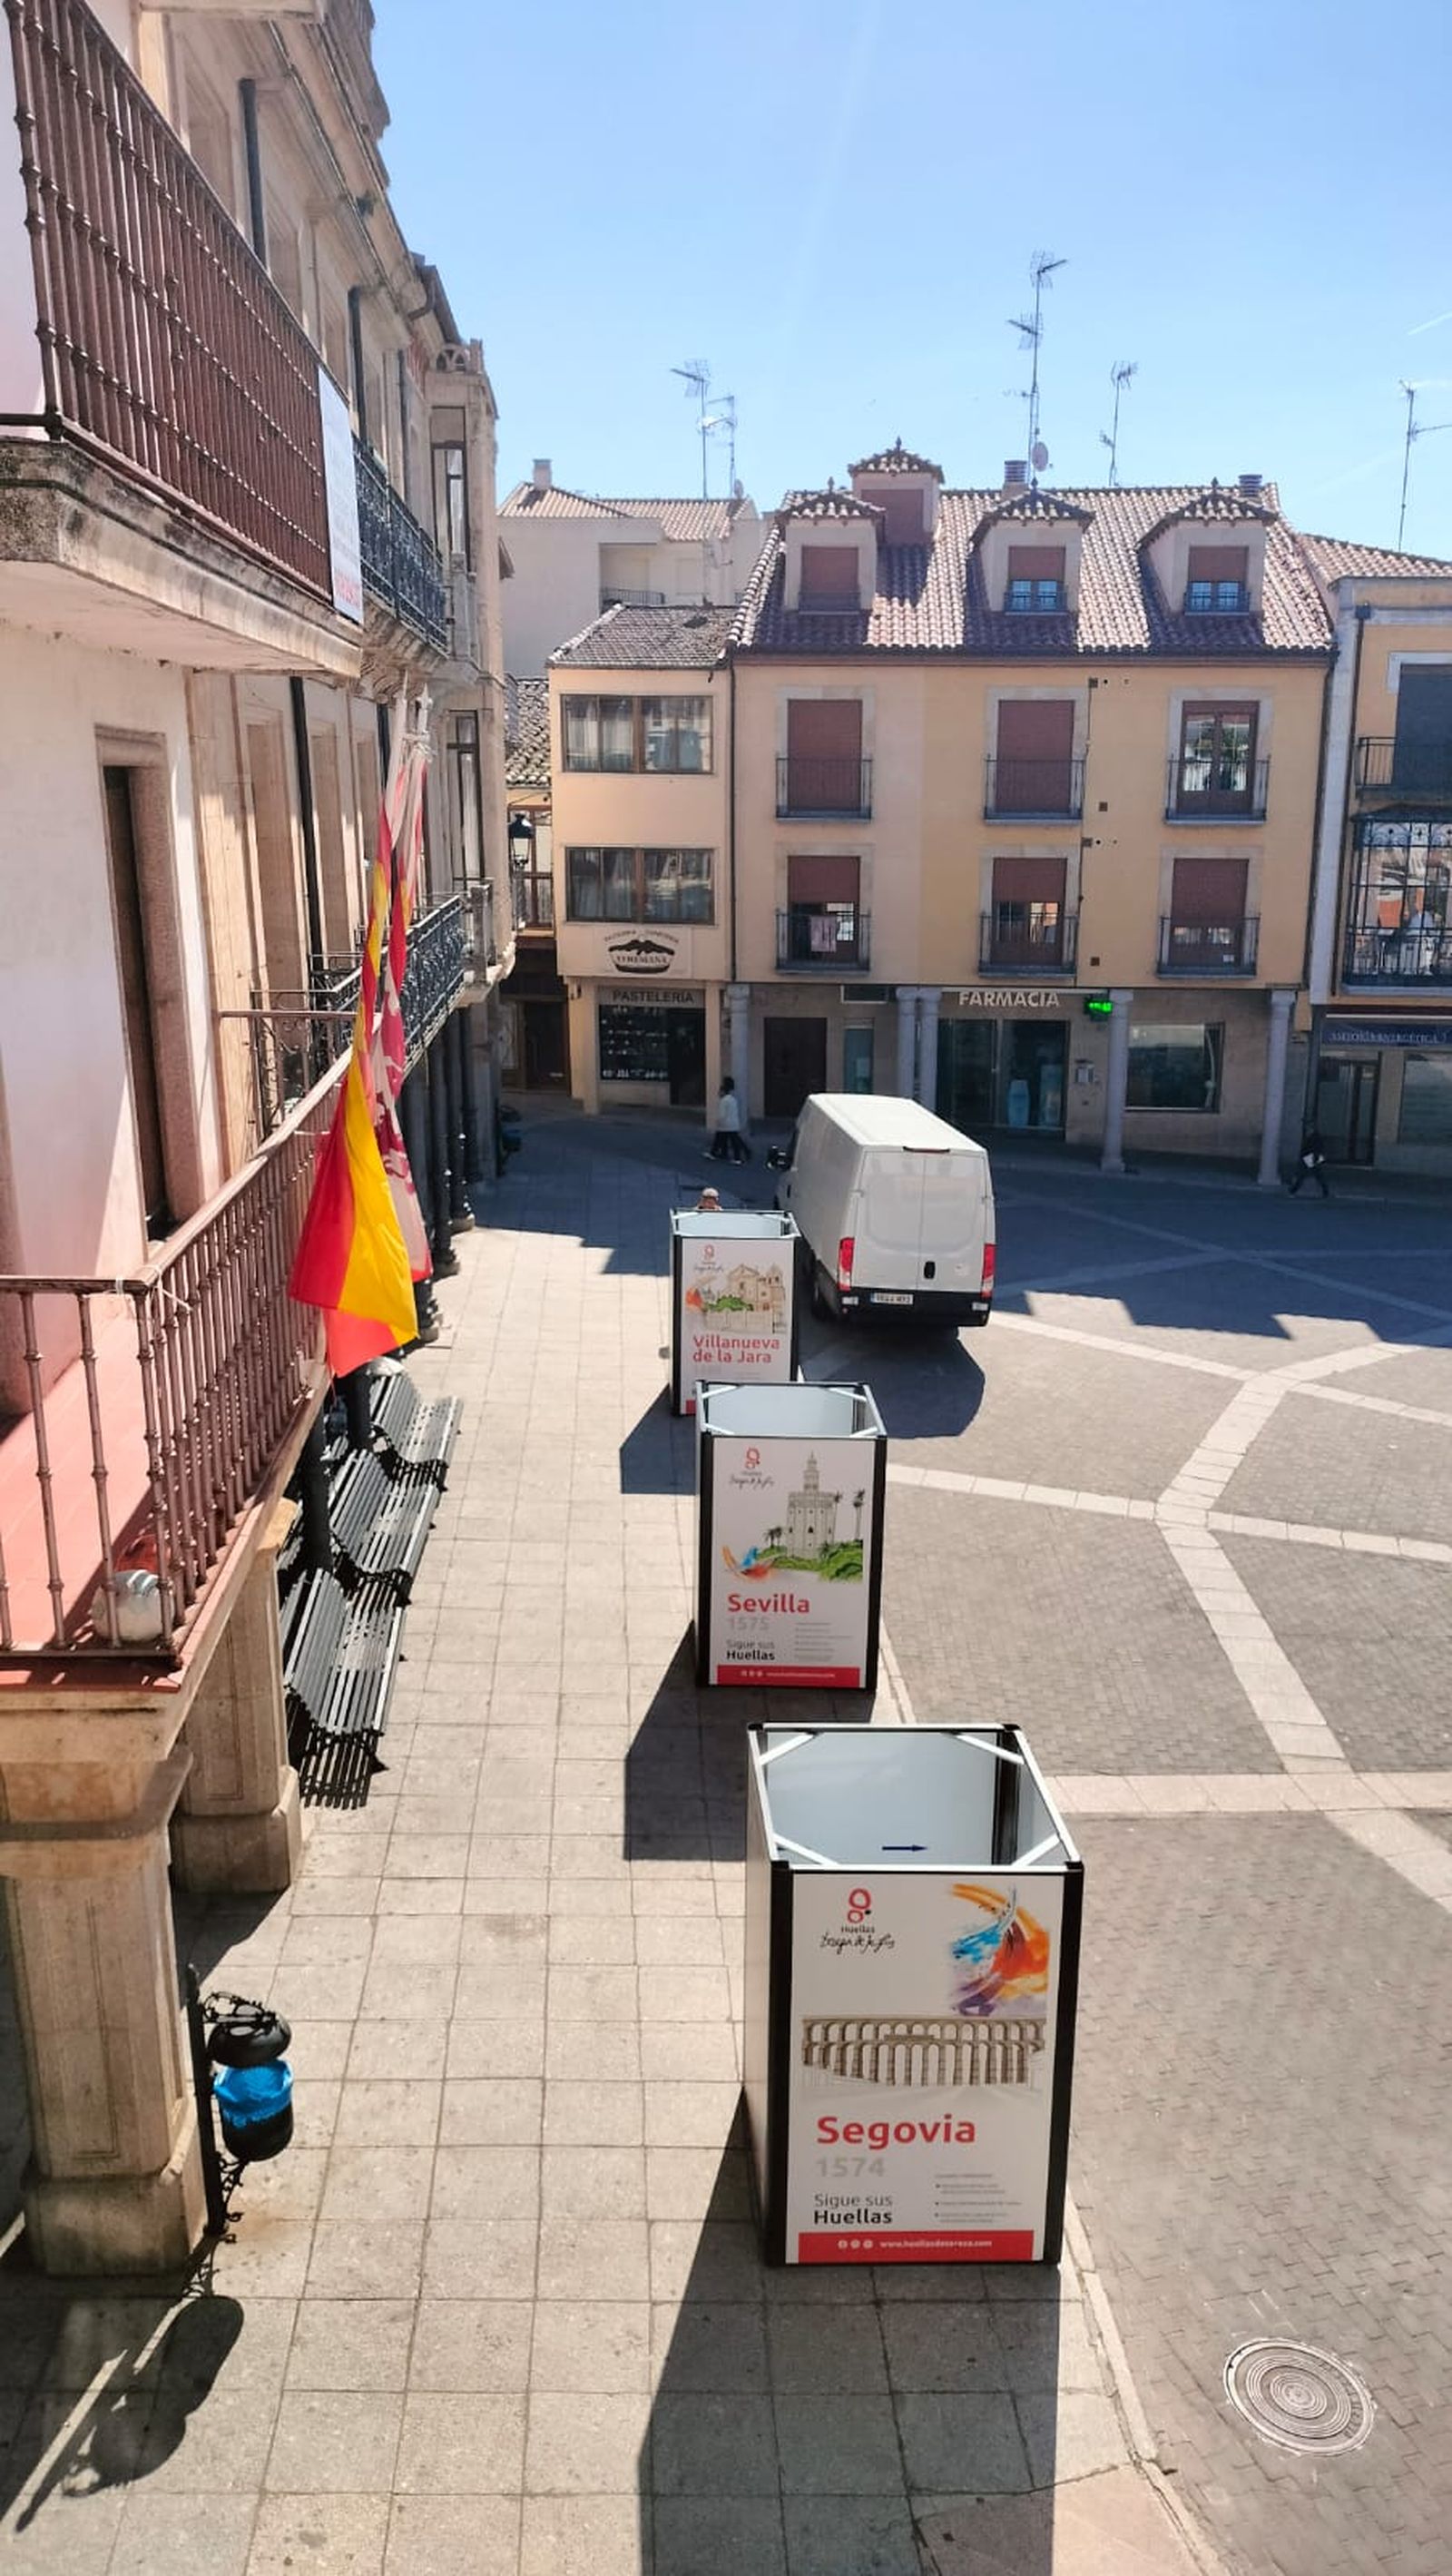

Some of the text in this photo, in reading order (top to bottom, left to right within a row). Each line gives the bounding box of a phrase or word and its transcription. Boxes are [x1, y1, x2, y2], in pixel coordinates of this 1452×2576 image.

[959, 991, 1060, 1008] FARMACIA
[692, 1334, 780, 1350] Villanueva
[692, 1349, 772, 1363] de la Jara
[727, 1593, 810, 1614] Sevilla
[727, 1617, 770, 1631] 1575
[726, 1649, 776, 1661] Huellas
[817, 2114, 976, 2149] Segovia
[815, 2156, 886, 2178] 1574
[814, 2193, 893, 2210] Sigue sus
[813, 2208, 893, 2225] Huellas
